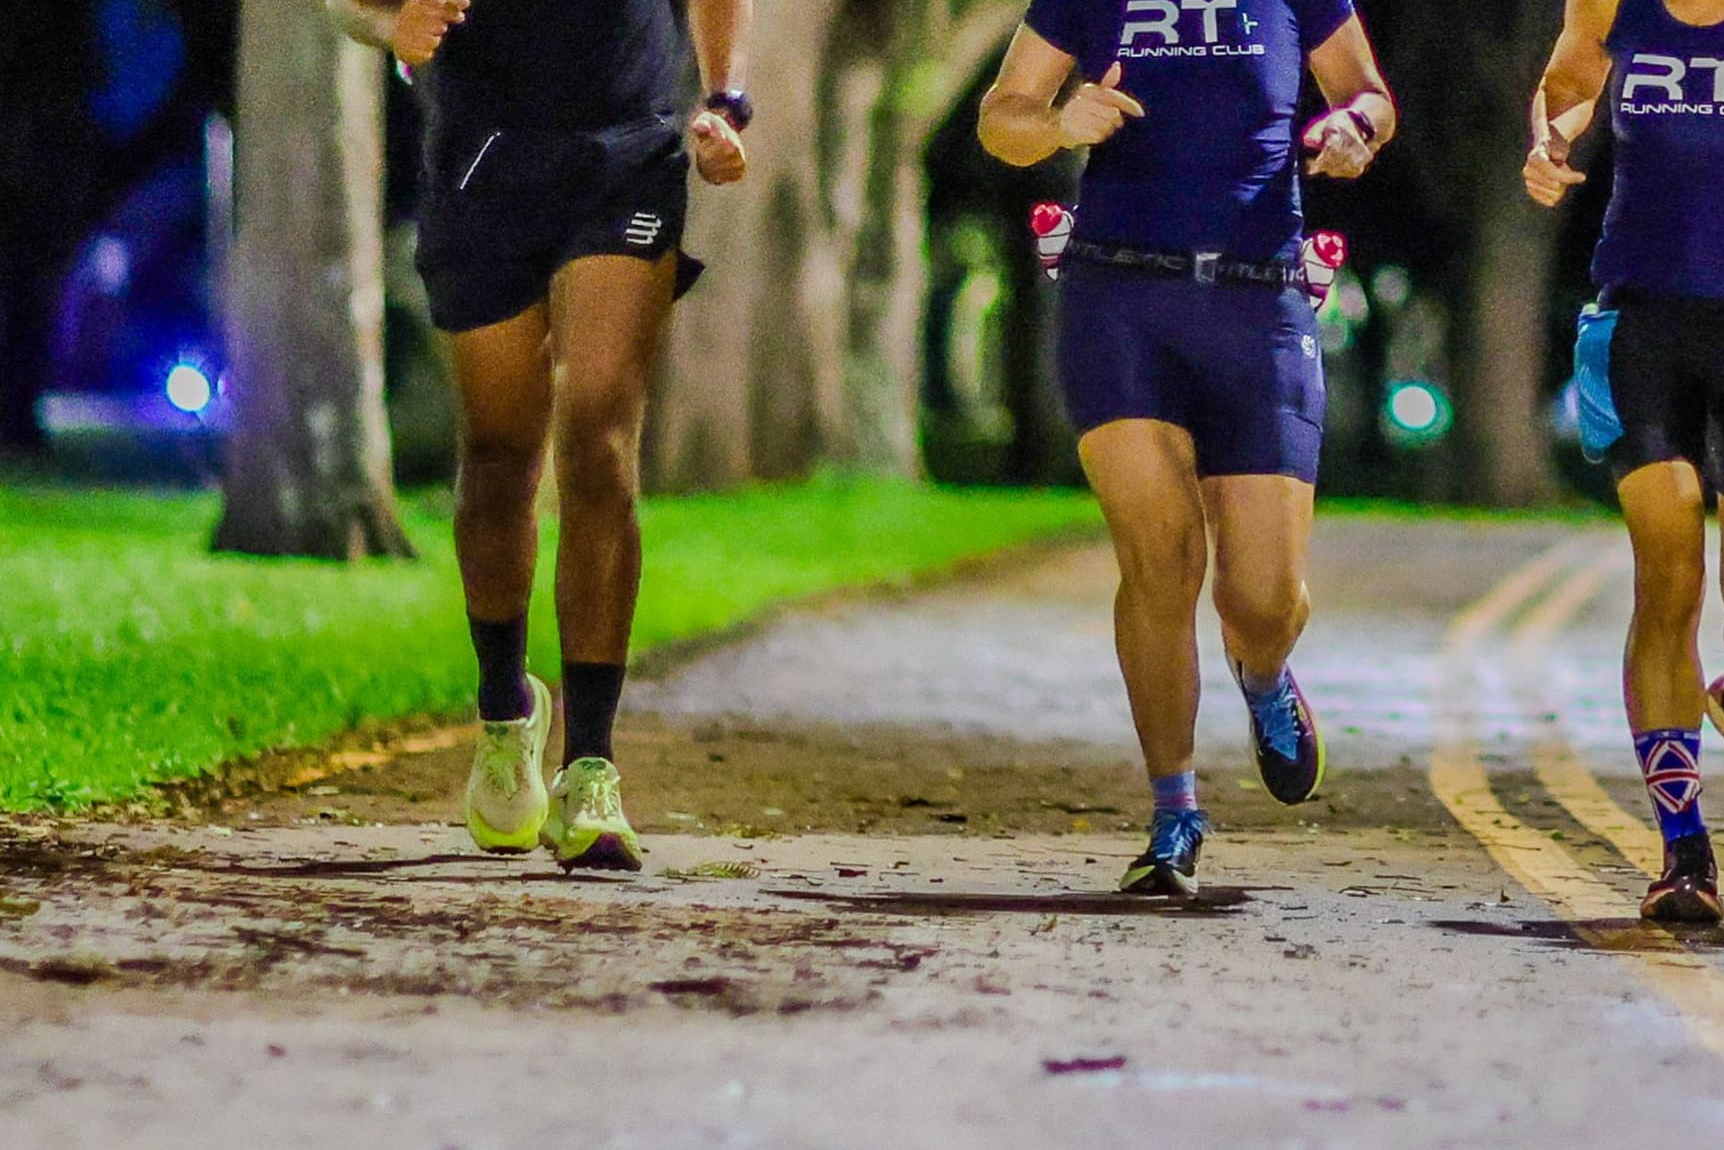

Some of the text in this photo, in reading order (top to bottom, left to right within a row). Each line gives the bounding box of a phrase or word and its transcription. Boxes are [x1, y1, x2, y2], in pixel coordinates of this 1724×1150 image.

[1117, 44, 1265, 58] RUNNING CLUB
[1620, 102, 1714, 115] RUNNING
